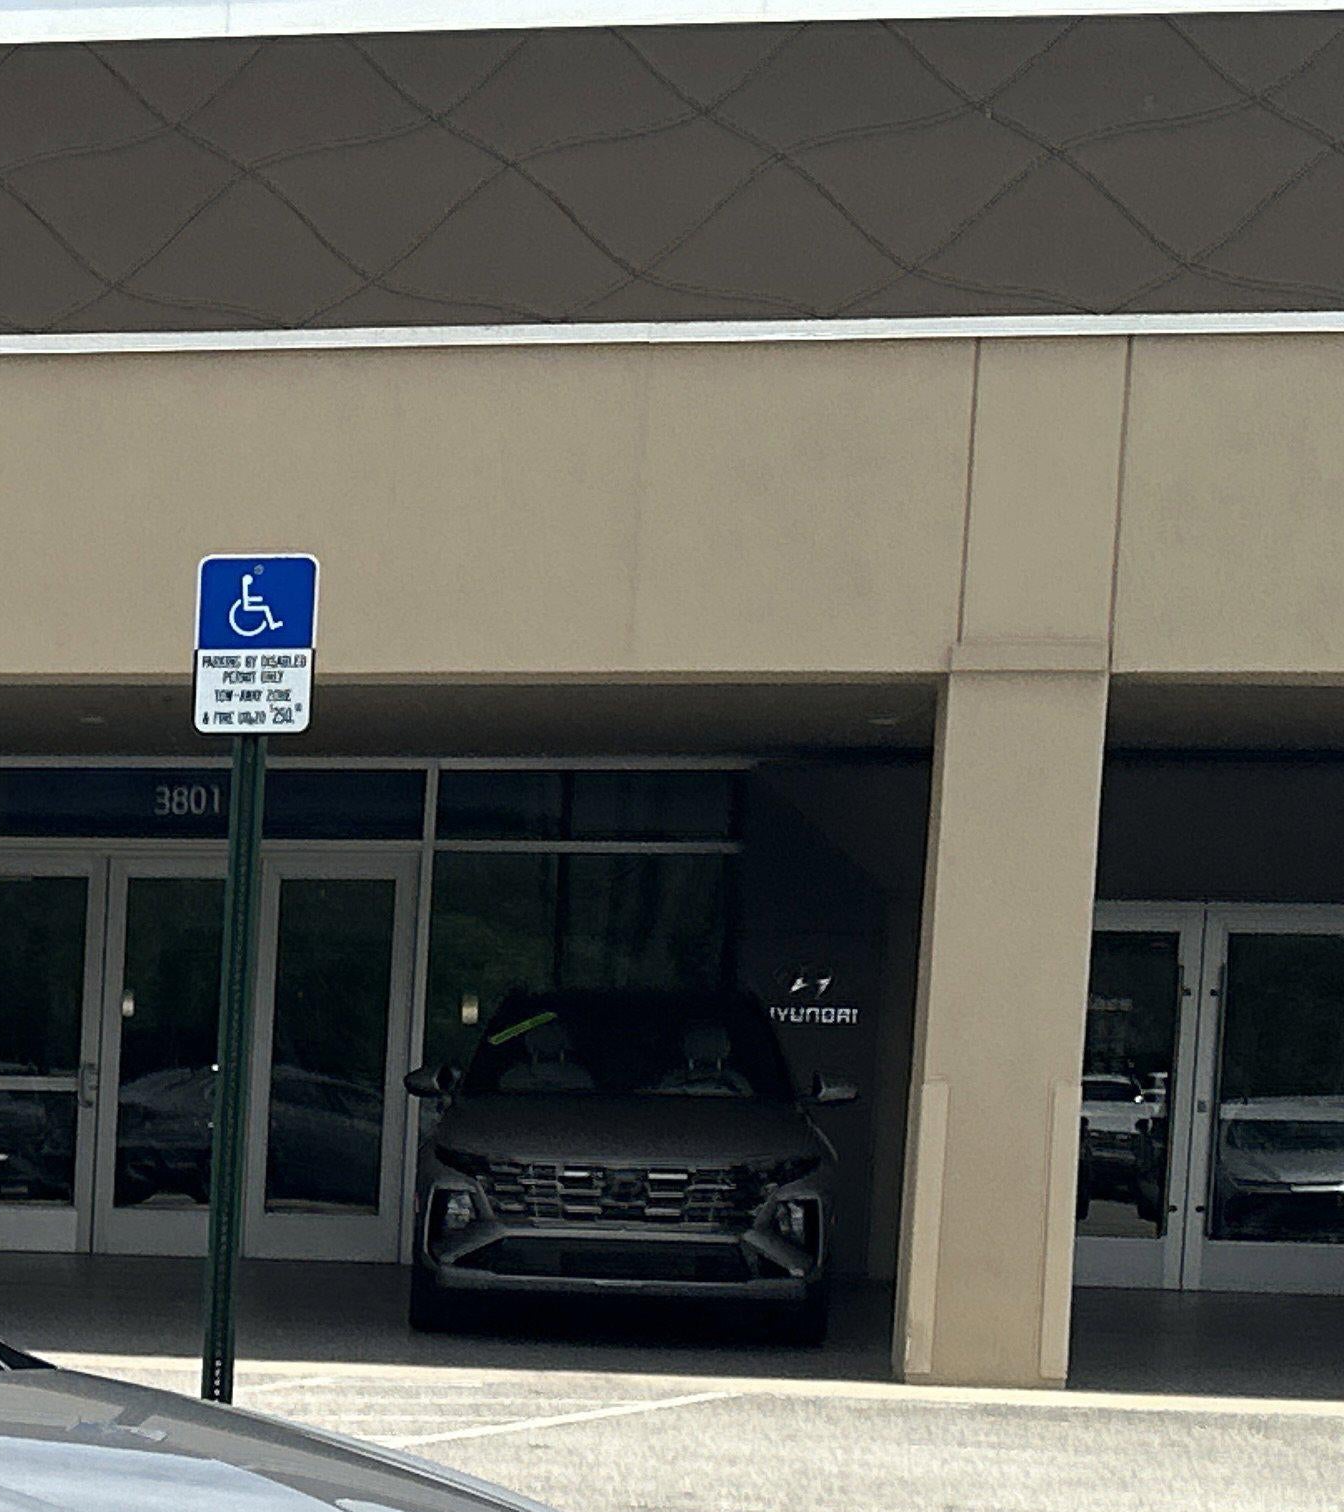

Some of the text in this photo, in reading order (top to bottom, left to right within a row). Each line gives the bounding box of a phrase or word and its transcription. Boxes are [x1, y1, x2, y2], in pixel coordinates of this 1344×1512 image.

[202, 654, 306, 668] PARKING BY DISABLED
[261, 671, 284, 683] ONLY
[154, 785, 220, 815] 3801
